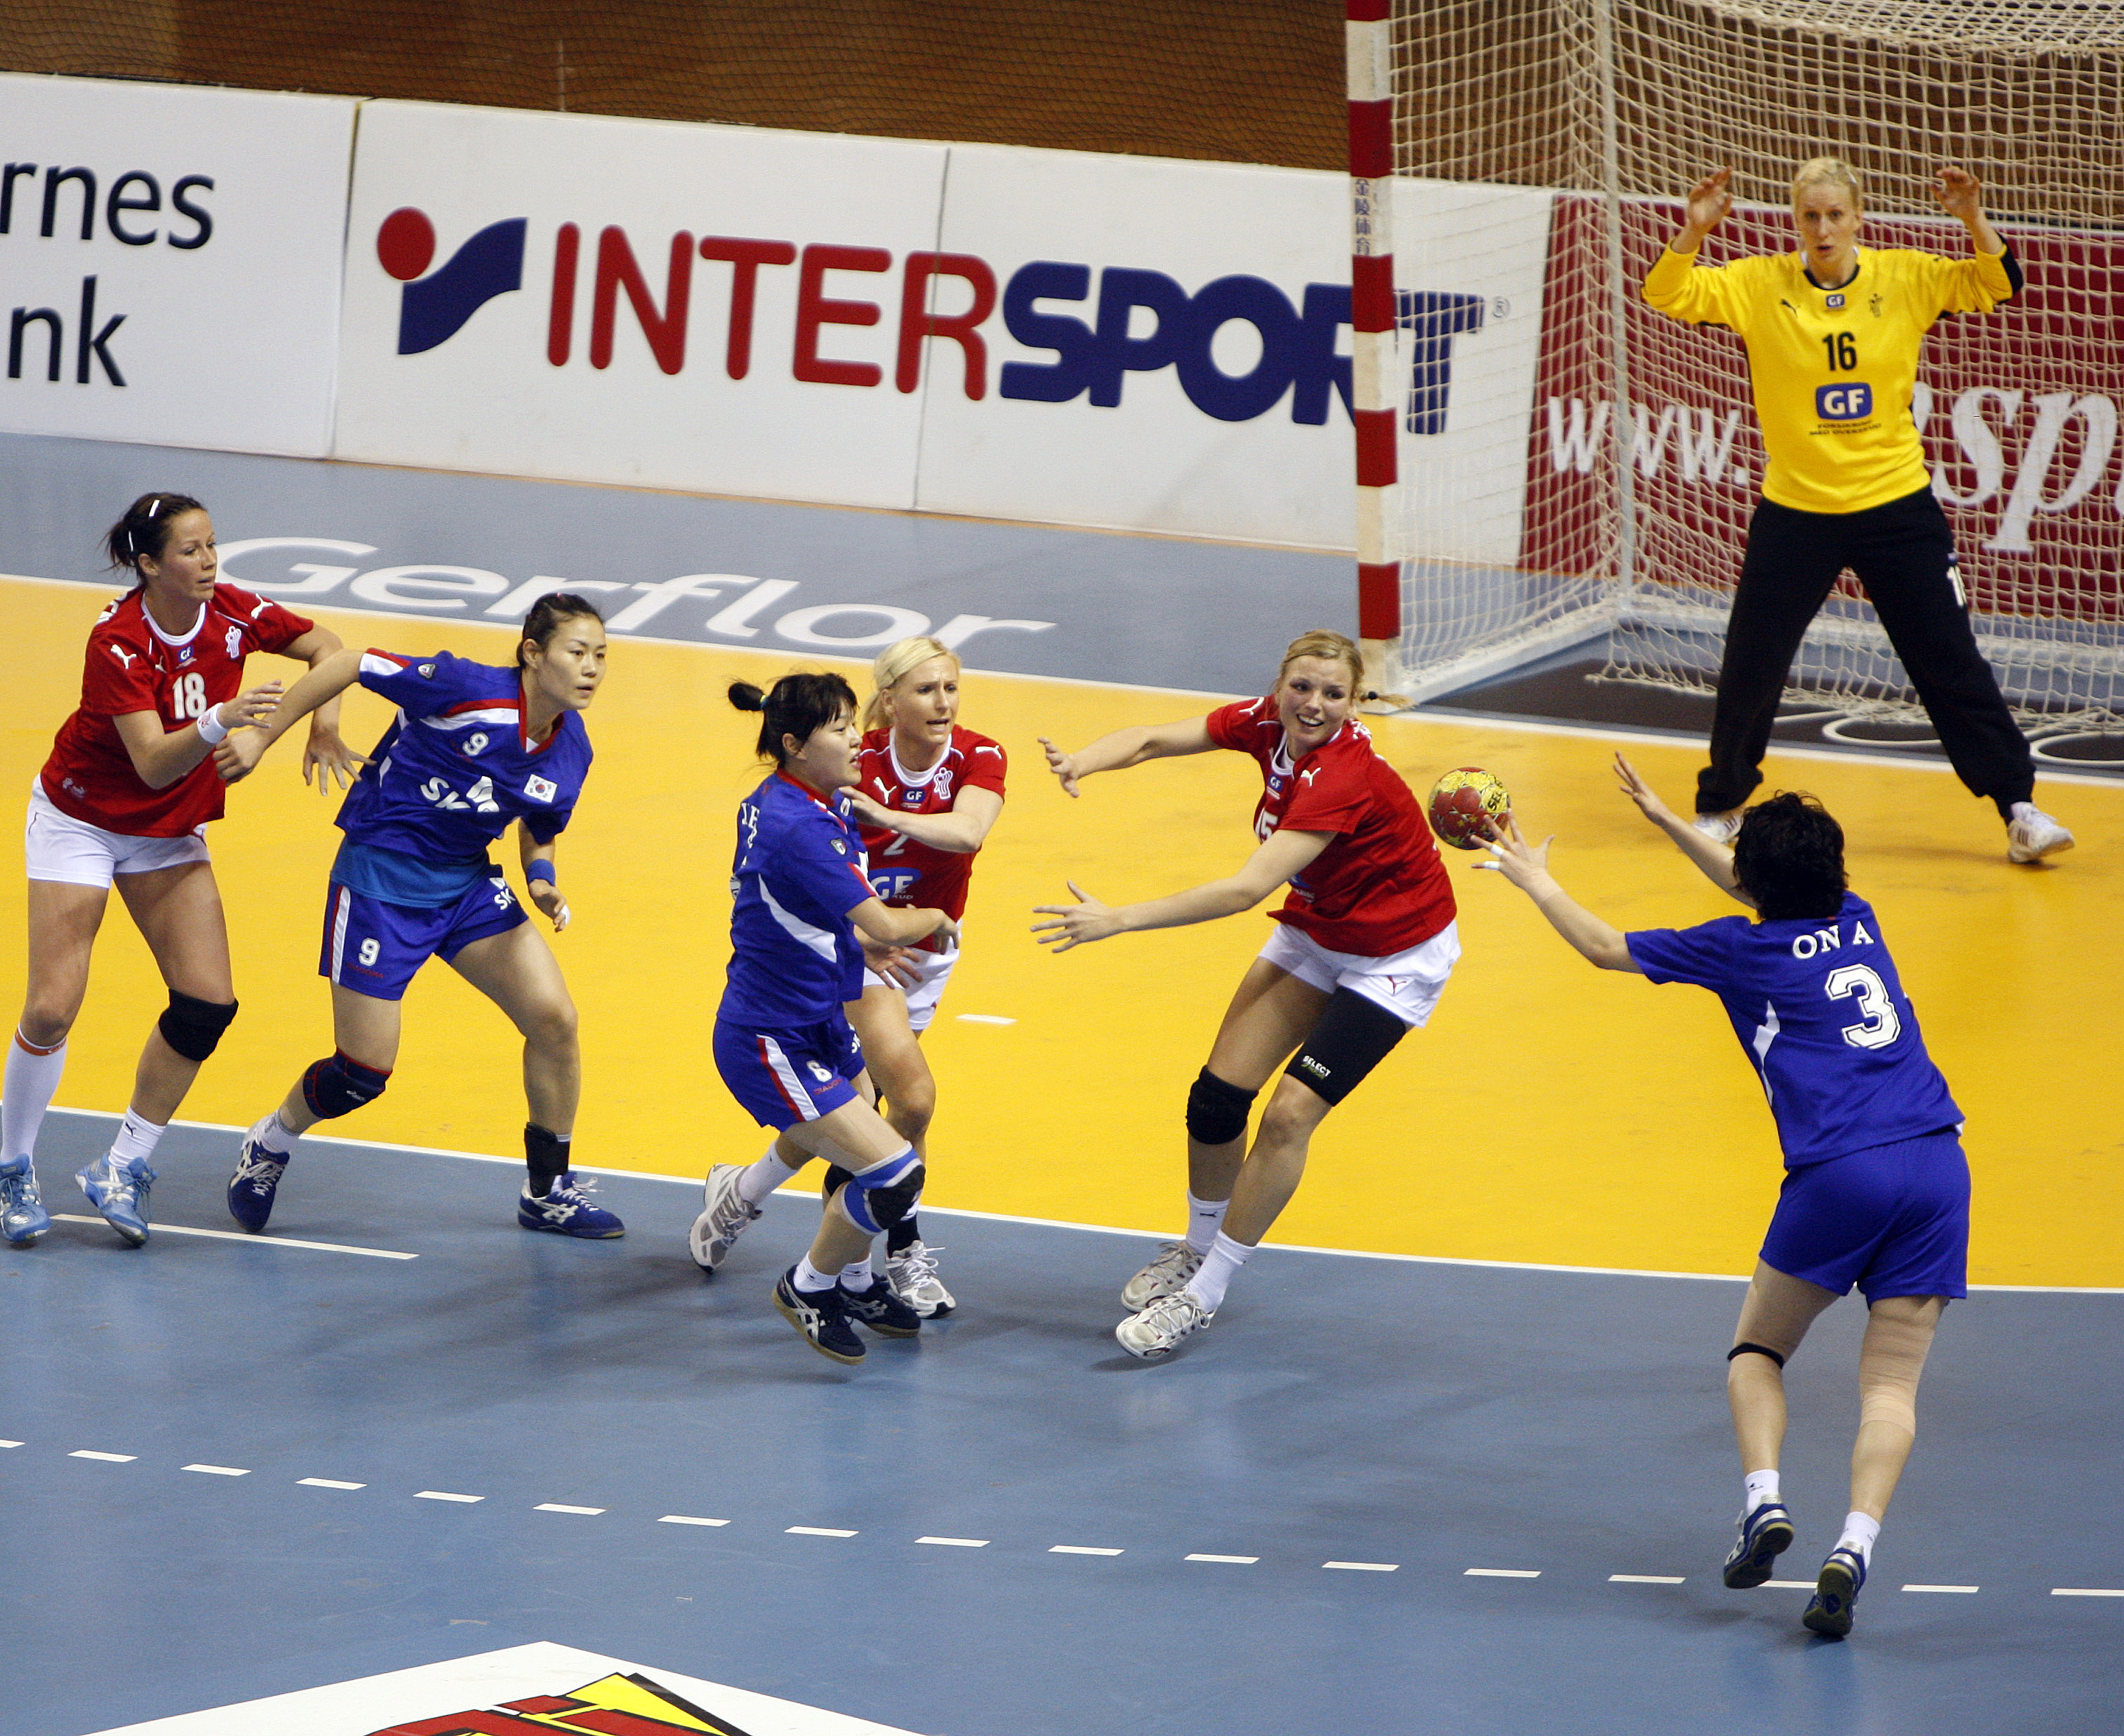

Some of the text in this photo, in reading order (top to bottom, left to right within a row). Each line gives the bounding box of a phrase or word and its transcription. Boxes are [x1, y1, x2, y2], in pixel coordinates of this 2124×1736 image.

[0, 162, 215, 249] rnes
[1827, 294, 1844, 307] GF
[8, 275, 128, 387] nk
[1822, 331, 1857, 371] 16
[1824, 388, 1864, 415] GF
[215, 537, 1058, 651] Gerflor
[172, 672, 207, 720] 18
[462, 731, 489, 757] 9
[906, 791, 923, 801] GF
[1270, 776, 1281, 789] GF
[494, 888, 516, 910] SK
[870, 875, 914, 900] GF
[358, 937, 380, 966] 9
[1792, 921, 1874, 959] ON A
[1825, 963, 1901, 1049] 3
[806, 1060, 833, 1083] 8
[1302, 1055, 1331, 1077] SELECT
